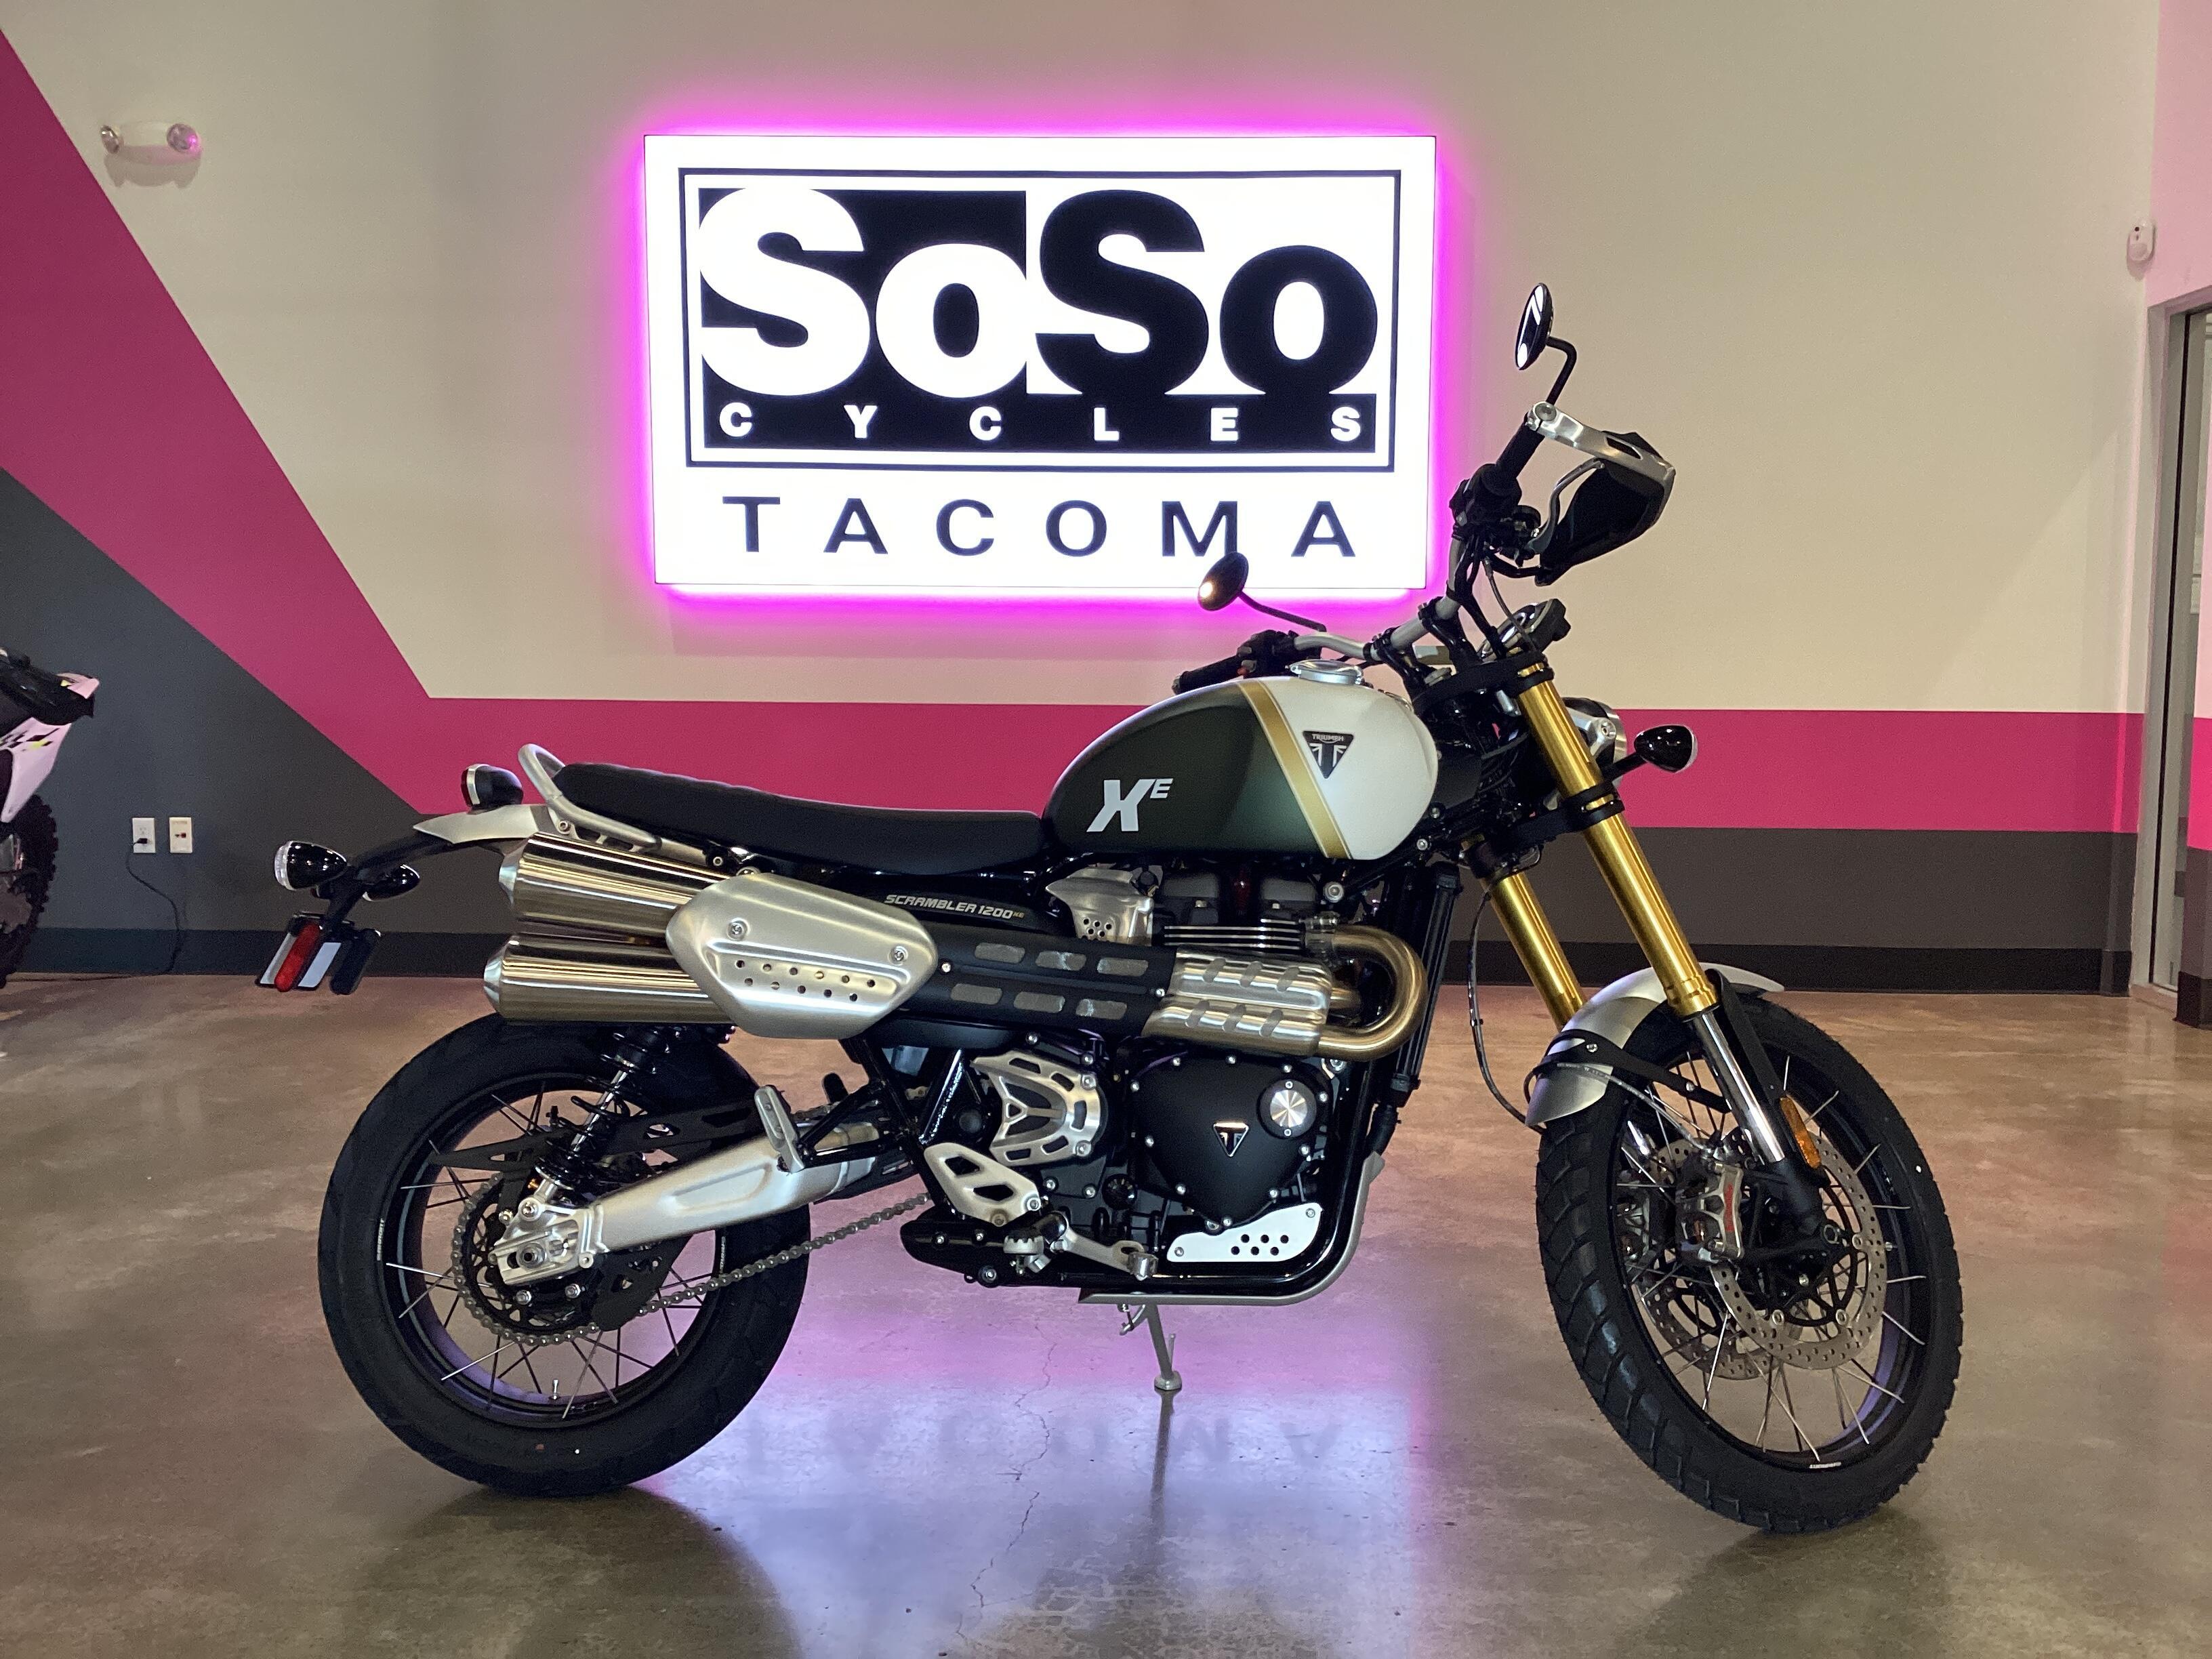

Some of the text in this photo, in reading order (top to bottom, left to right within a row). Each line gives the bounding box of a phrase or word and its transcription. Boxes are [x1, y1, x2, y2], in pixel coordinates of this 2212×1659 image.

[698, 187, 1378, 398] SoSo
[718, 402, 1361, 443] CYCLES
[722, 496, 1356, 558] TACOMA
[1311, 733, 1345, 743] TRIUMPH
[884, 894, 977, 914] SCRAMBLER
